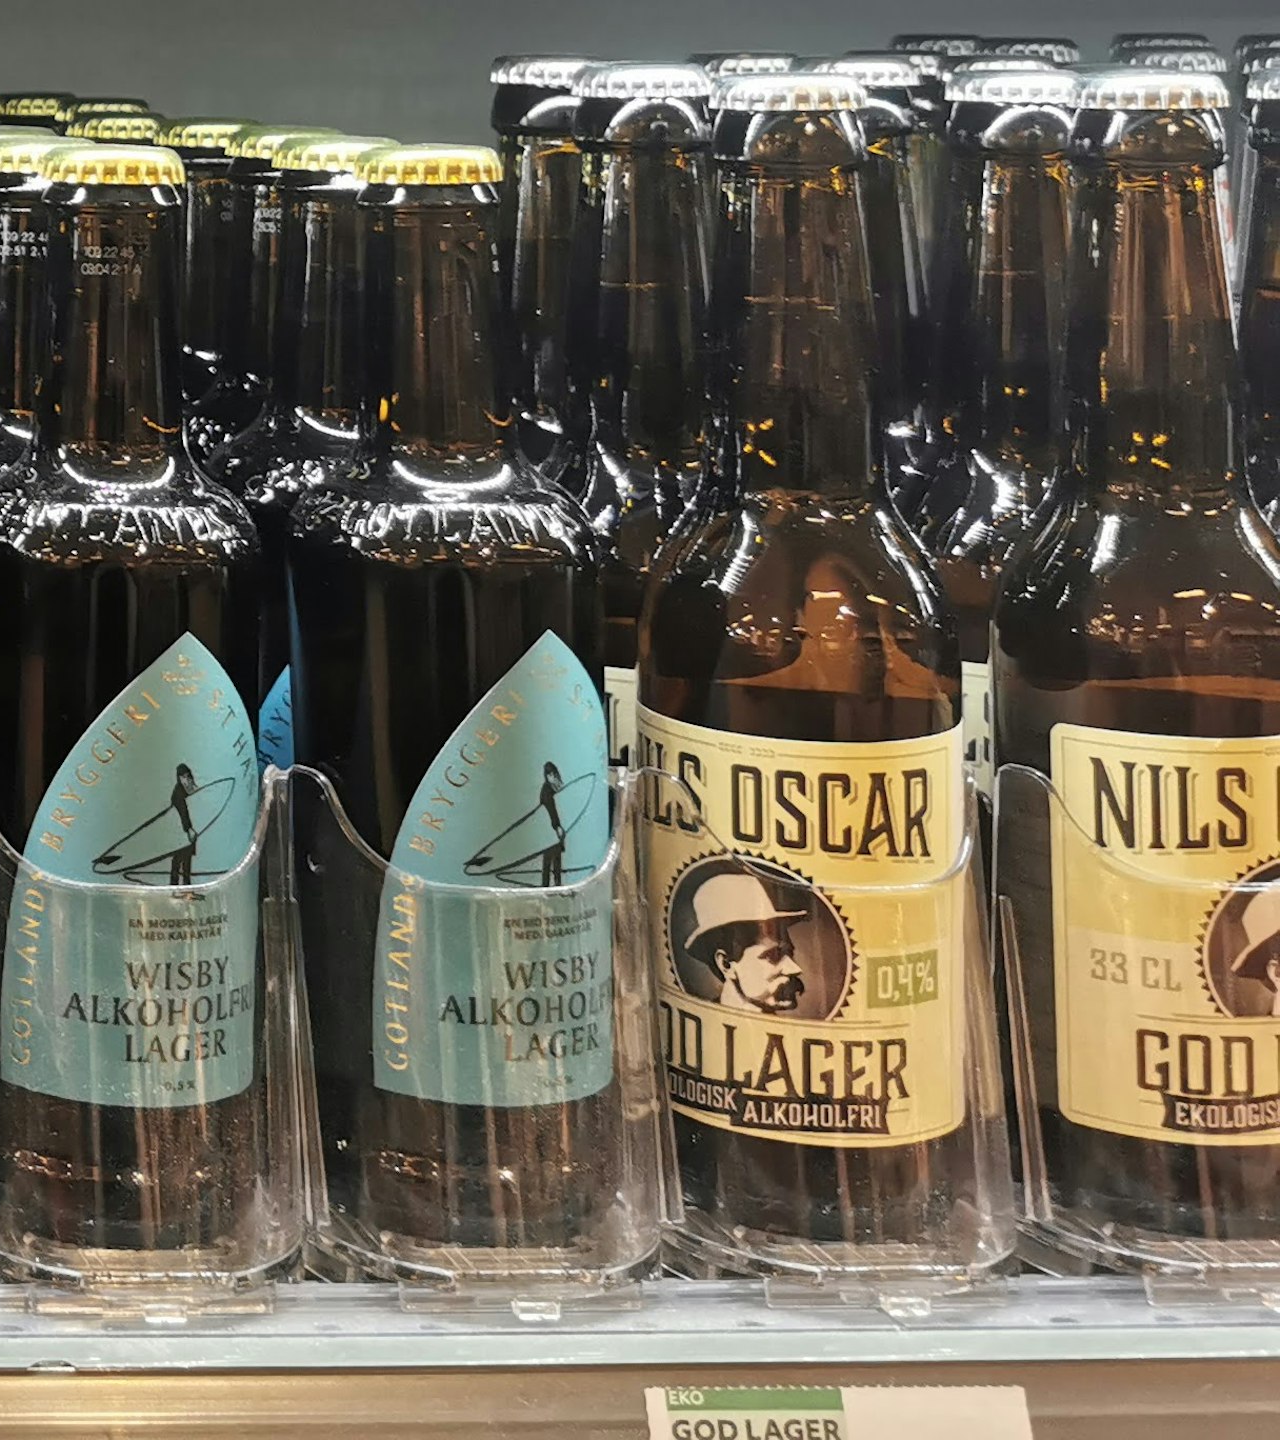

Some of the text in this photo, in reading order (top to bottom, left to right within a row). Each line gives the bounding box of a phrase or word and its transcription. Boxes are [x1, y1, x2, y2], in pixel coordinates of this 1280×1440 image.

[42, 688, 163, 853] BRYGGERI
[408, 690, 530, 856] BRYGGERI
[730, 763, 931, 858] OSCAR
[1090, 757, 1250, 851] NILS
[124, 957, 230, 992] WISBY
[504, 951, 601, 991] WISBY
[877, 959, 935, 1002] 0,4%
[1090, 947, 1182, 992] 33 CL
[124, 1028, 228, 1065] LAGER
[505, 1024, 601, 1063] LAGER
[722, 1022, 910, 1102] LAGER
[1136, 1028, 1256, 1098] GOD
[742, 1099, 882, 1129] ALKOHOLFRI
[668, 1390, 704, 1405] EKO
[671, 1418, 840, 1440] GOD LAGER
